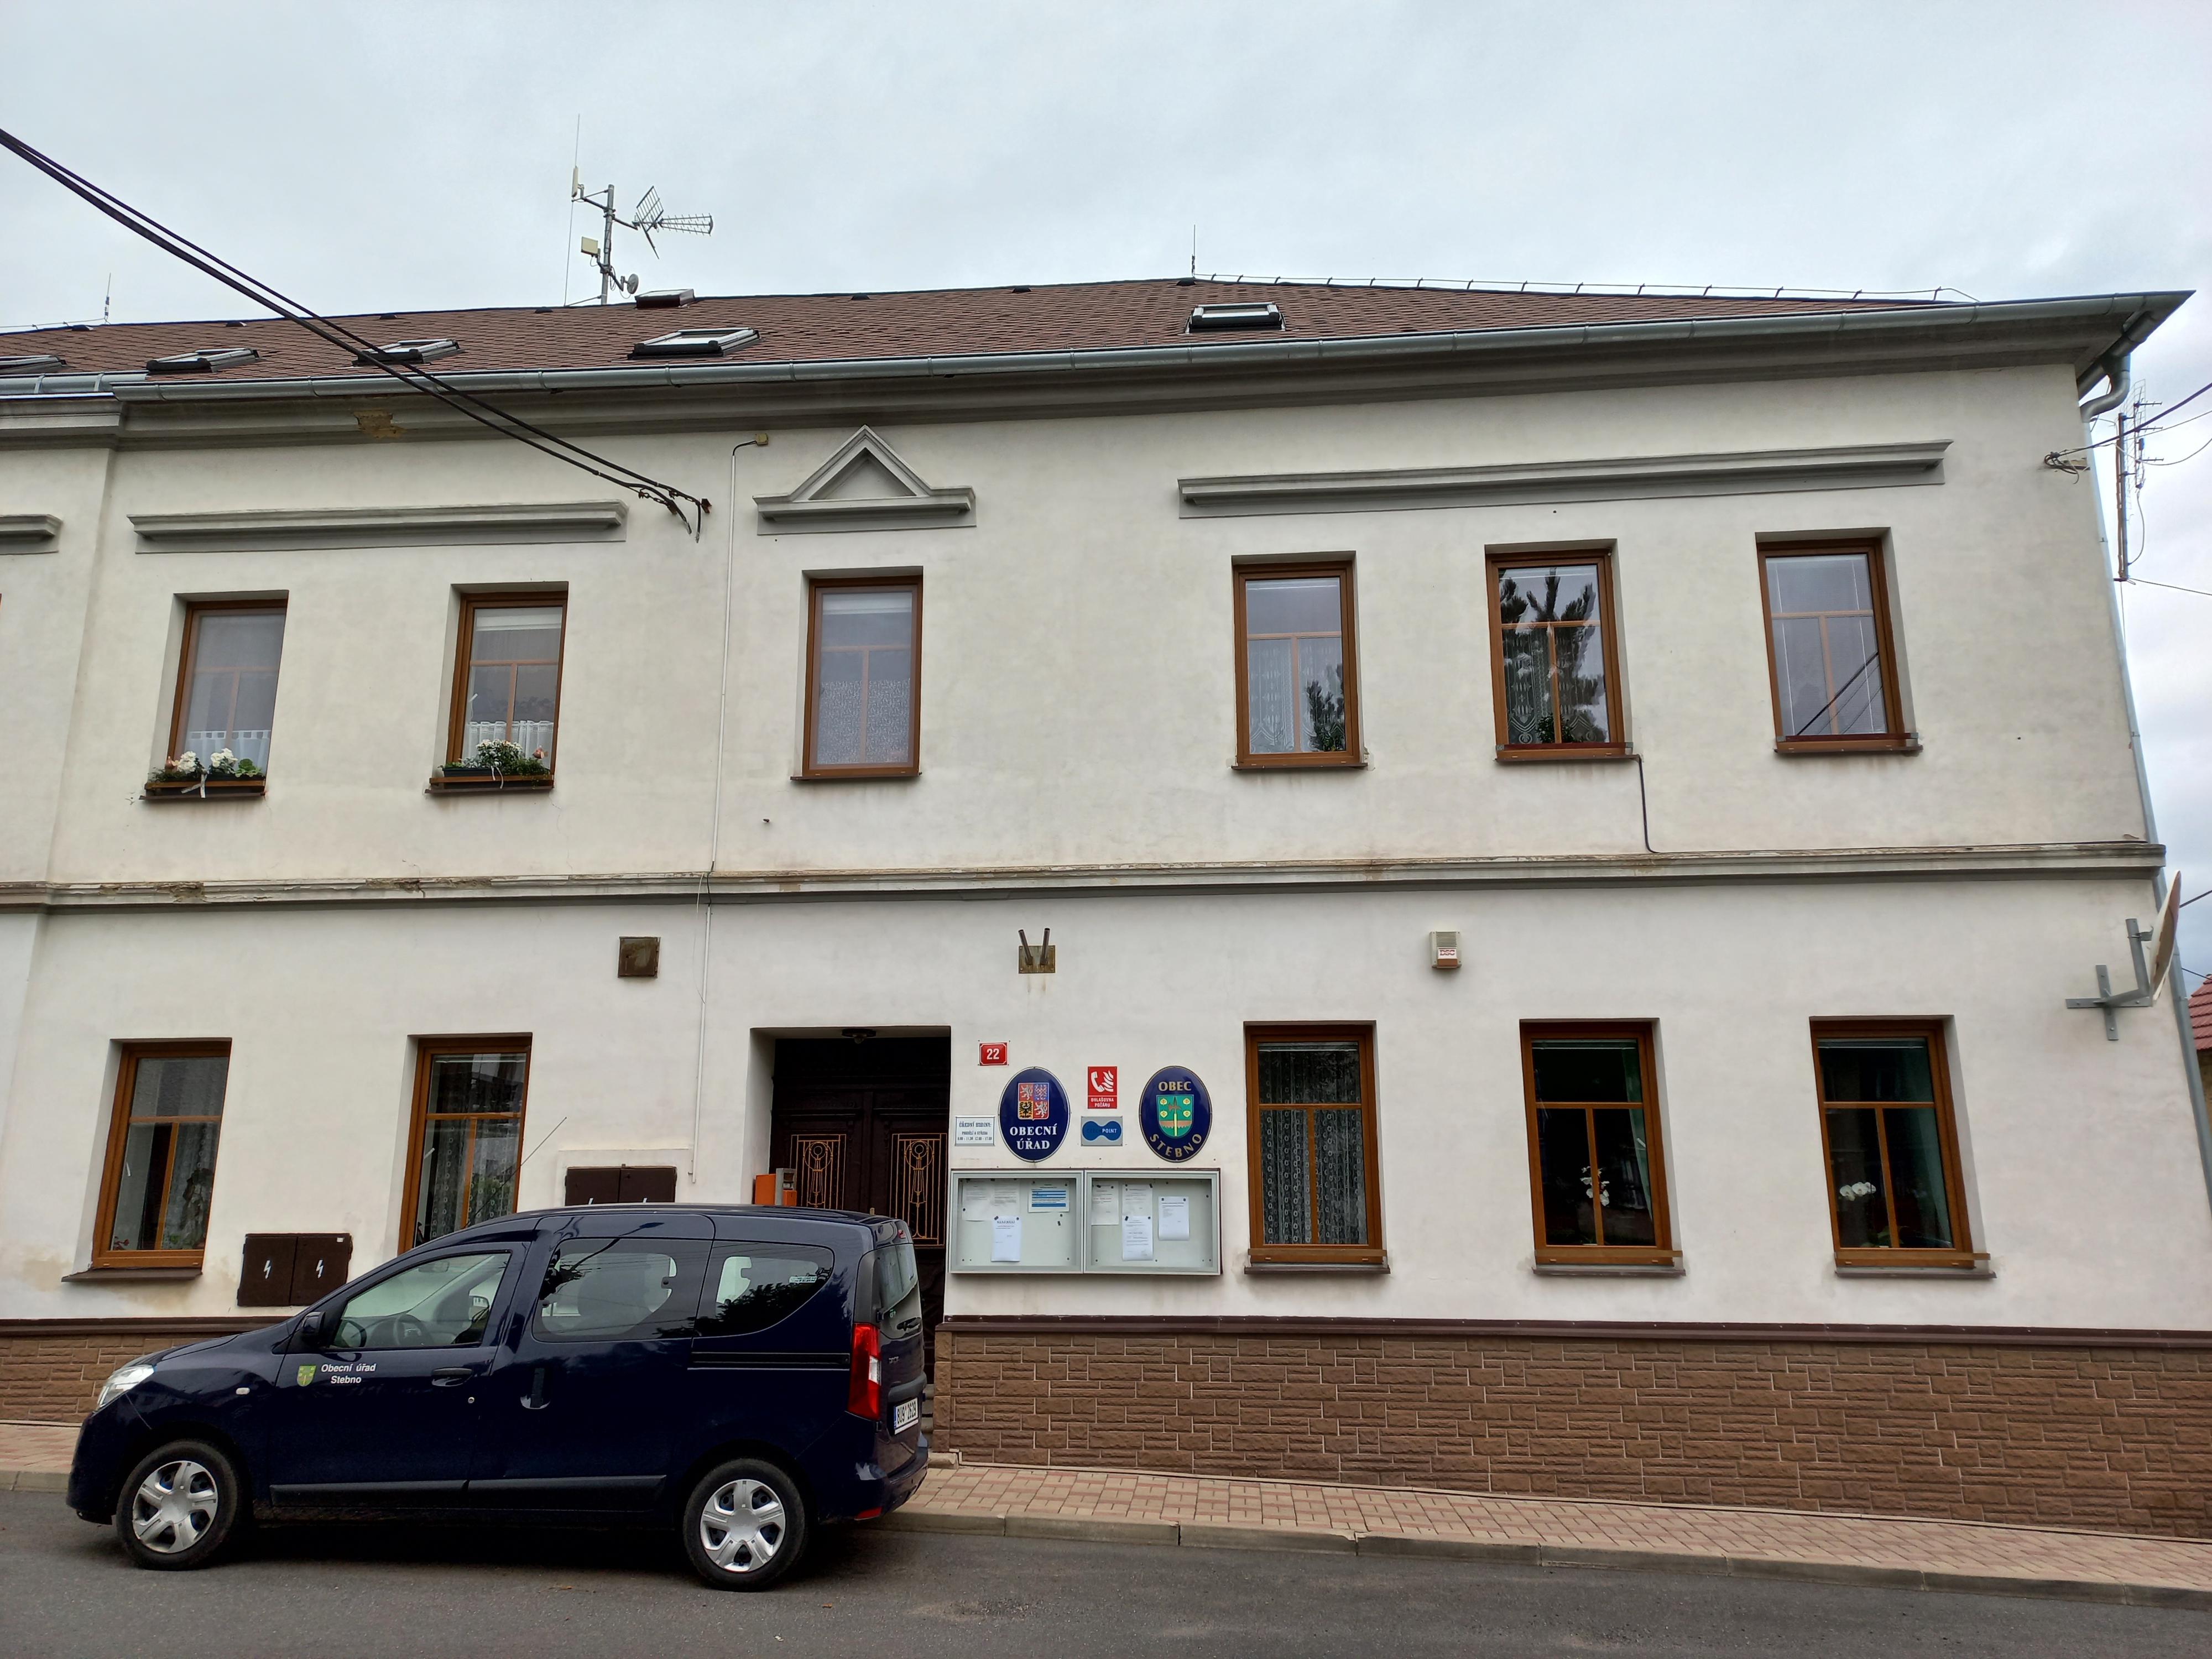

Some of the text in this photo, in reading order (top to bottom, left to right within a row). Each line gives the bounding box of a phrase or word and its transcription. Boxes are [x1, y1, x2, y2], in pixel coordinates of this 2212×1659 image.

[987, 1048, 999, 1060] 22
[1159, 1081, 1192, 1092] OBEC
[1009, 1123, 1057, 1136] OBECNÍ
[1016, 1138, 1050, 1150] ÚŘAD
[1150, 1134, 1202, 1157] STEBNO
[321, 1363, 377, 1373] Obecní úřad
[331, 1375, 362, 1384] Stebno
